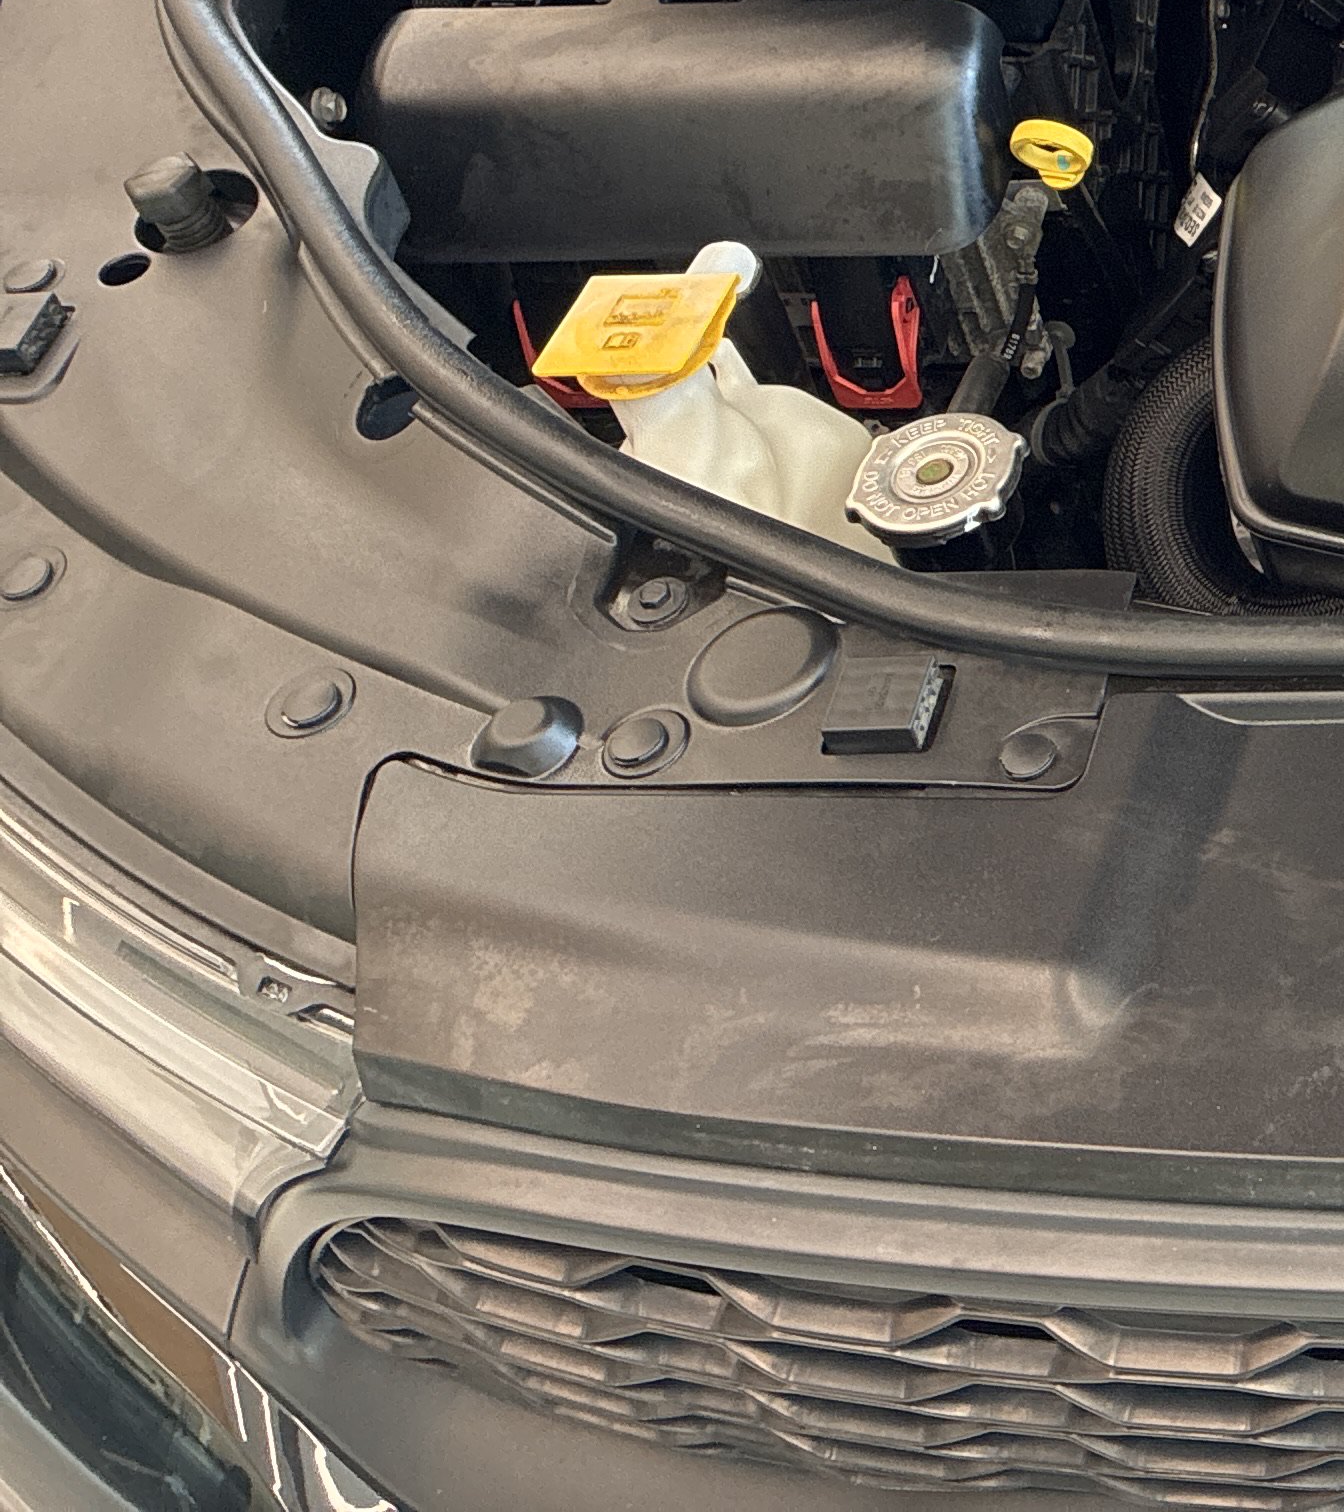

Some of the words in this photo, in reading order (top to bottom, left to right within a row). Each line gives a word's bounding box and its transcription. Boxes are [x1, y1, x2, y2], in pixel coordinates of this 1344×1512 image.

[892, 418, 947, 448] KEEP
[862, 470, 879, 493] DO
[961, 473, 996, 501] HOT
[866, 492, 901, 516] NOT
[902, 498, 959, 520] OPEN
